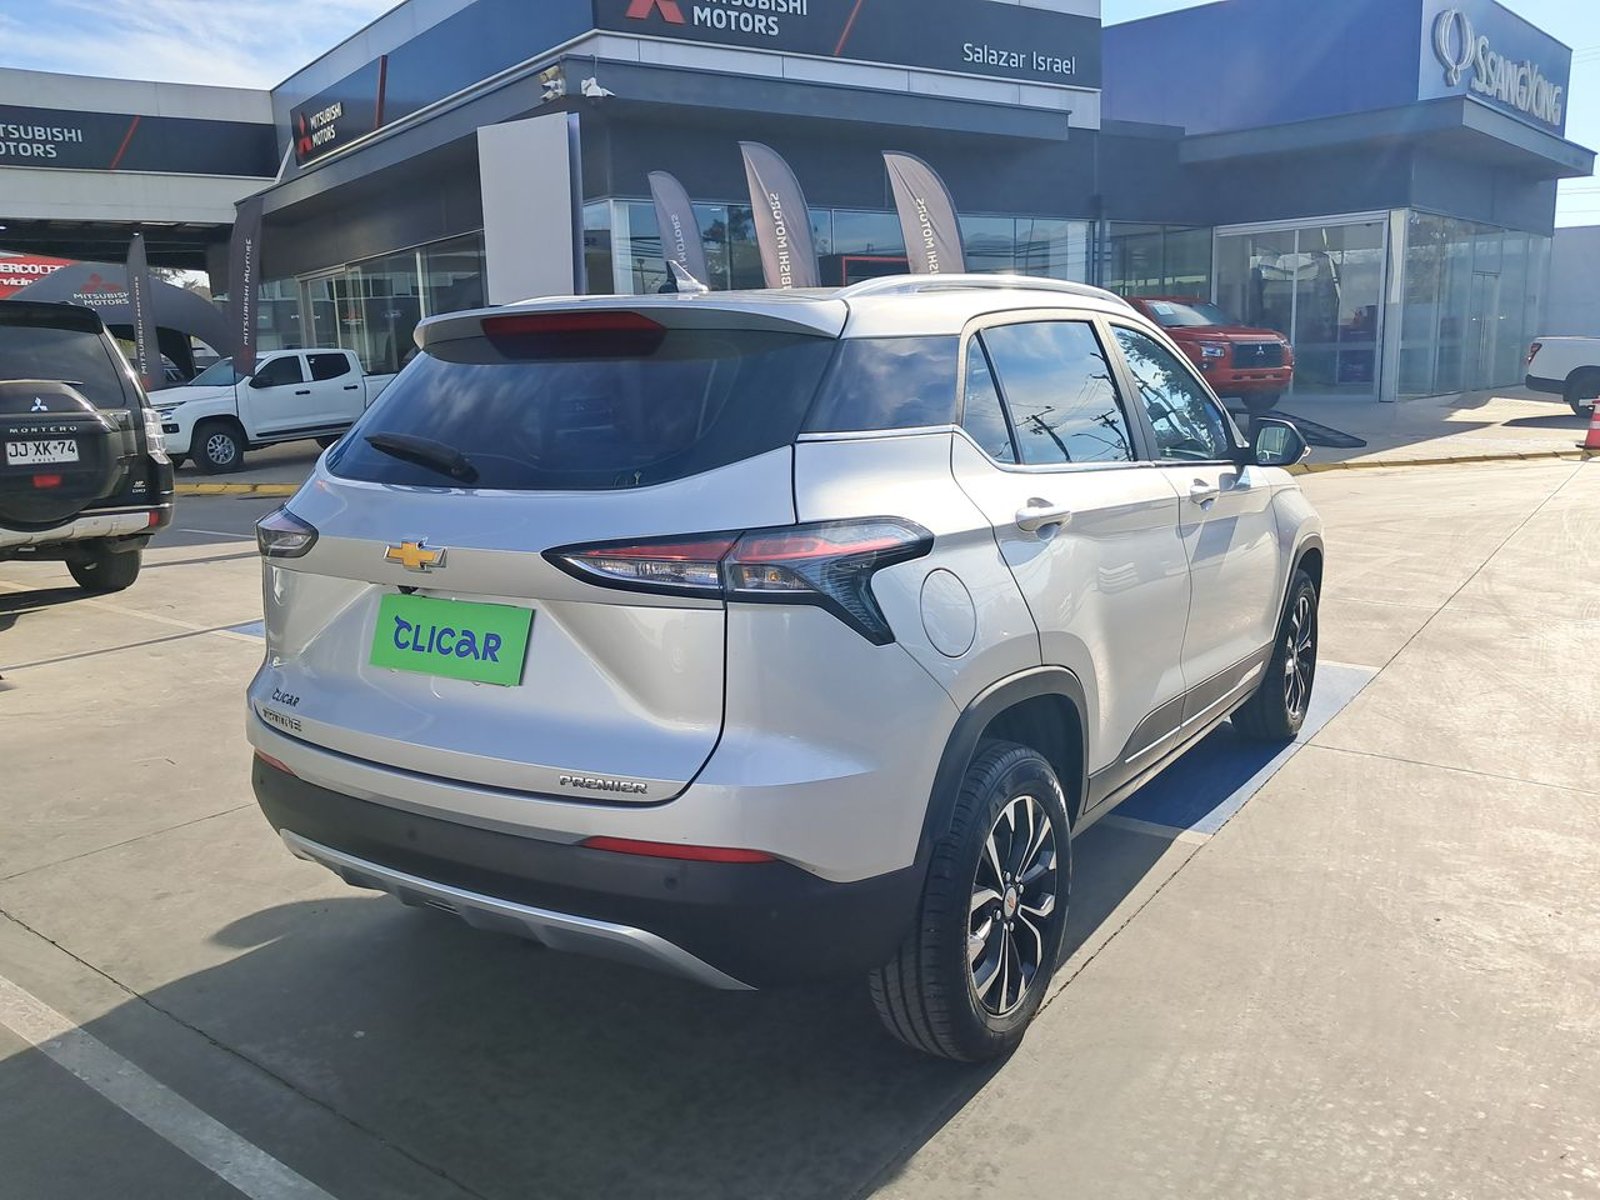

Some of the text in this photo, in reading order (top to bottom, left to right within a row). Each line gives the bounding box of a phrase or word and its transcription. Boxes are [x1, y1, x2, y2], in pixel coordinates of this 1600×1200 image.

[693, 5, 779, 36] MOTORS
[963, 43, 1076, 75] Salazar Israel
[309, 101, 342, 130] MITSUBISHI
[311, 124, 336, 148] MOTORS
[242, 285, 252, 346] MITSUBISHI
[9, 425, 78, 434] MONTERO
[559, 775, 648, 795] PREMIER
